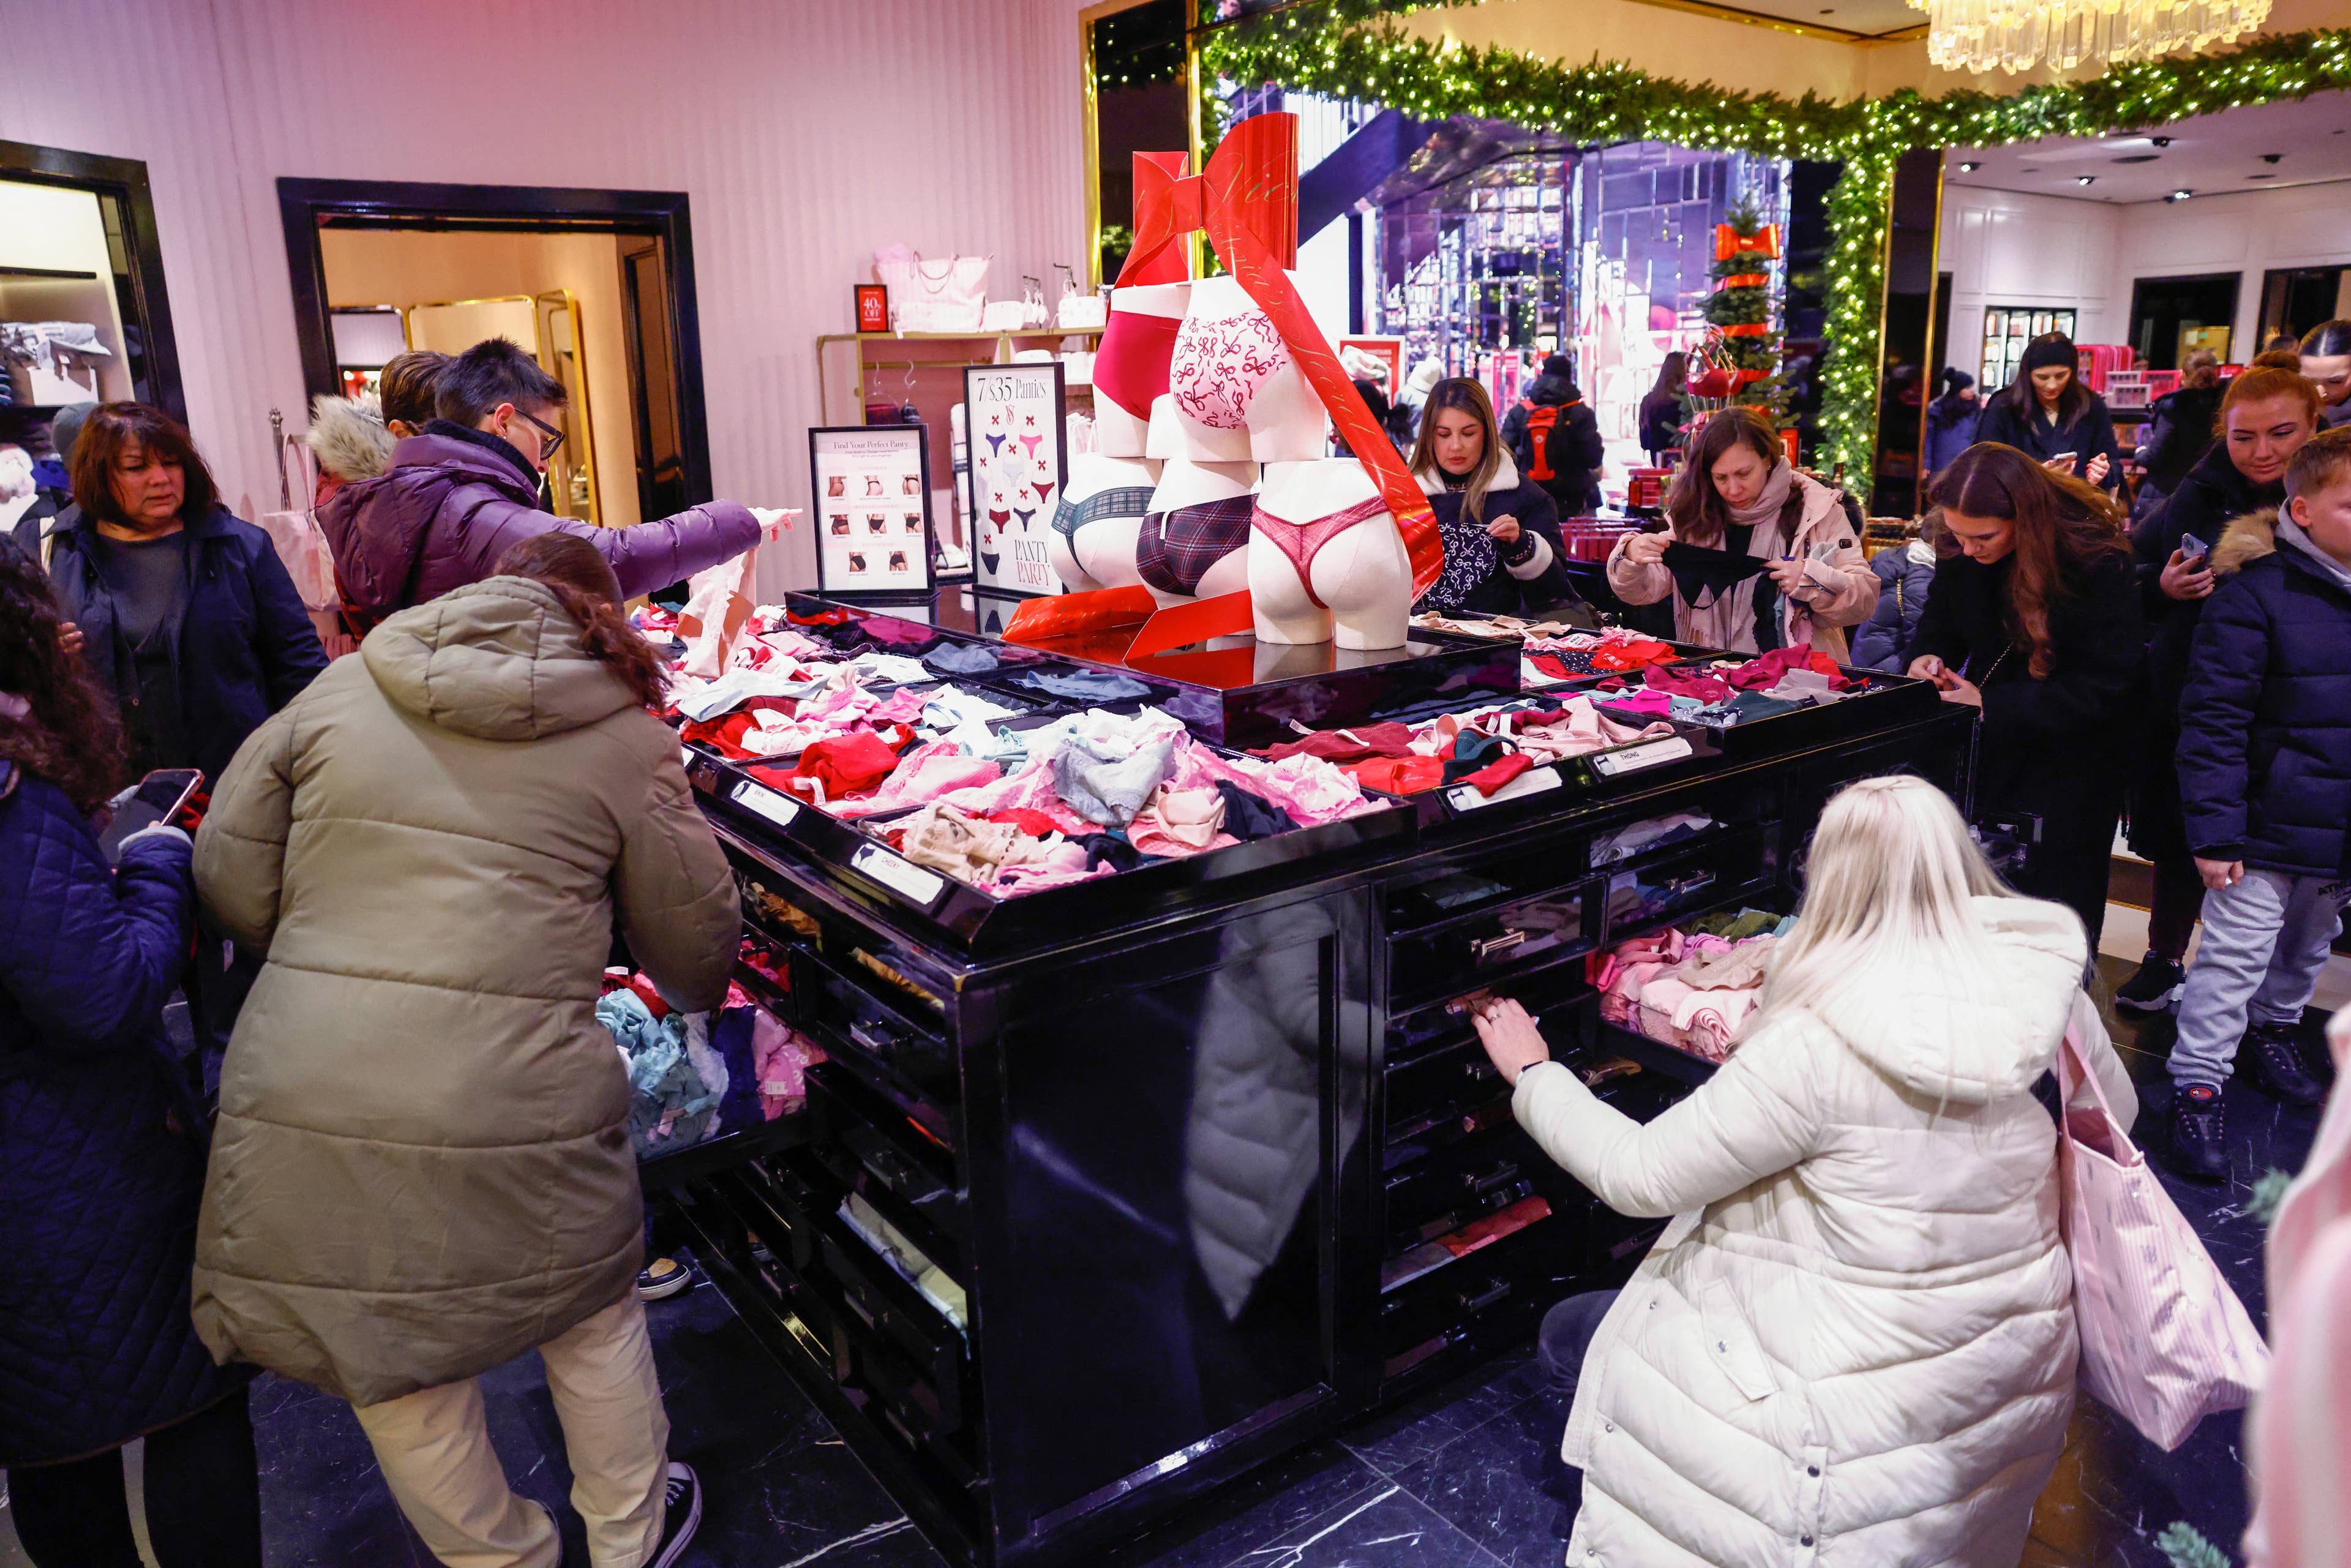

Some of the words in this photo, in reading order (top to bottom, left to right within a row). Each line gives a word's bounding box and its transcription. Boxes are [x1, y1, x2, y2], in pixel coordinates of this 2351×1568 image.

[1016, 378, 1046, 399] Panties
[890, 440, 909, 450] Panty
[1014, 539, 1048, 563] PANTY
[1017, 561, 1050, 586] PARTY
[1619, 751, 1640, 760] THONG
